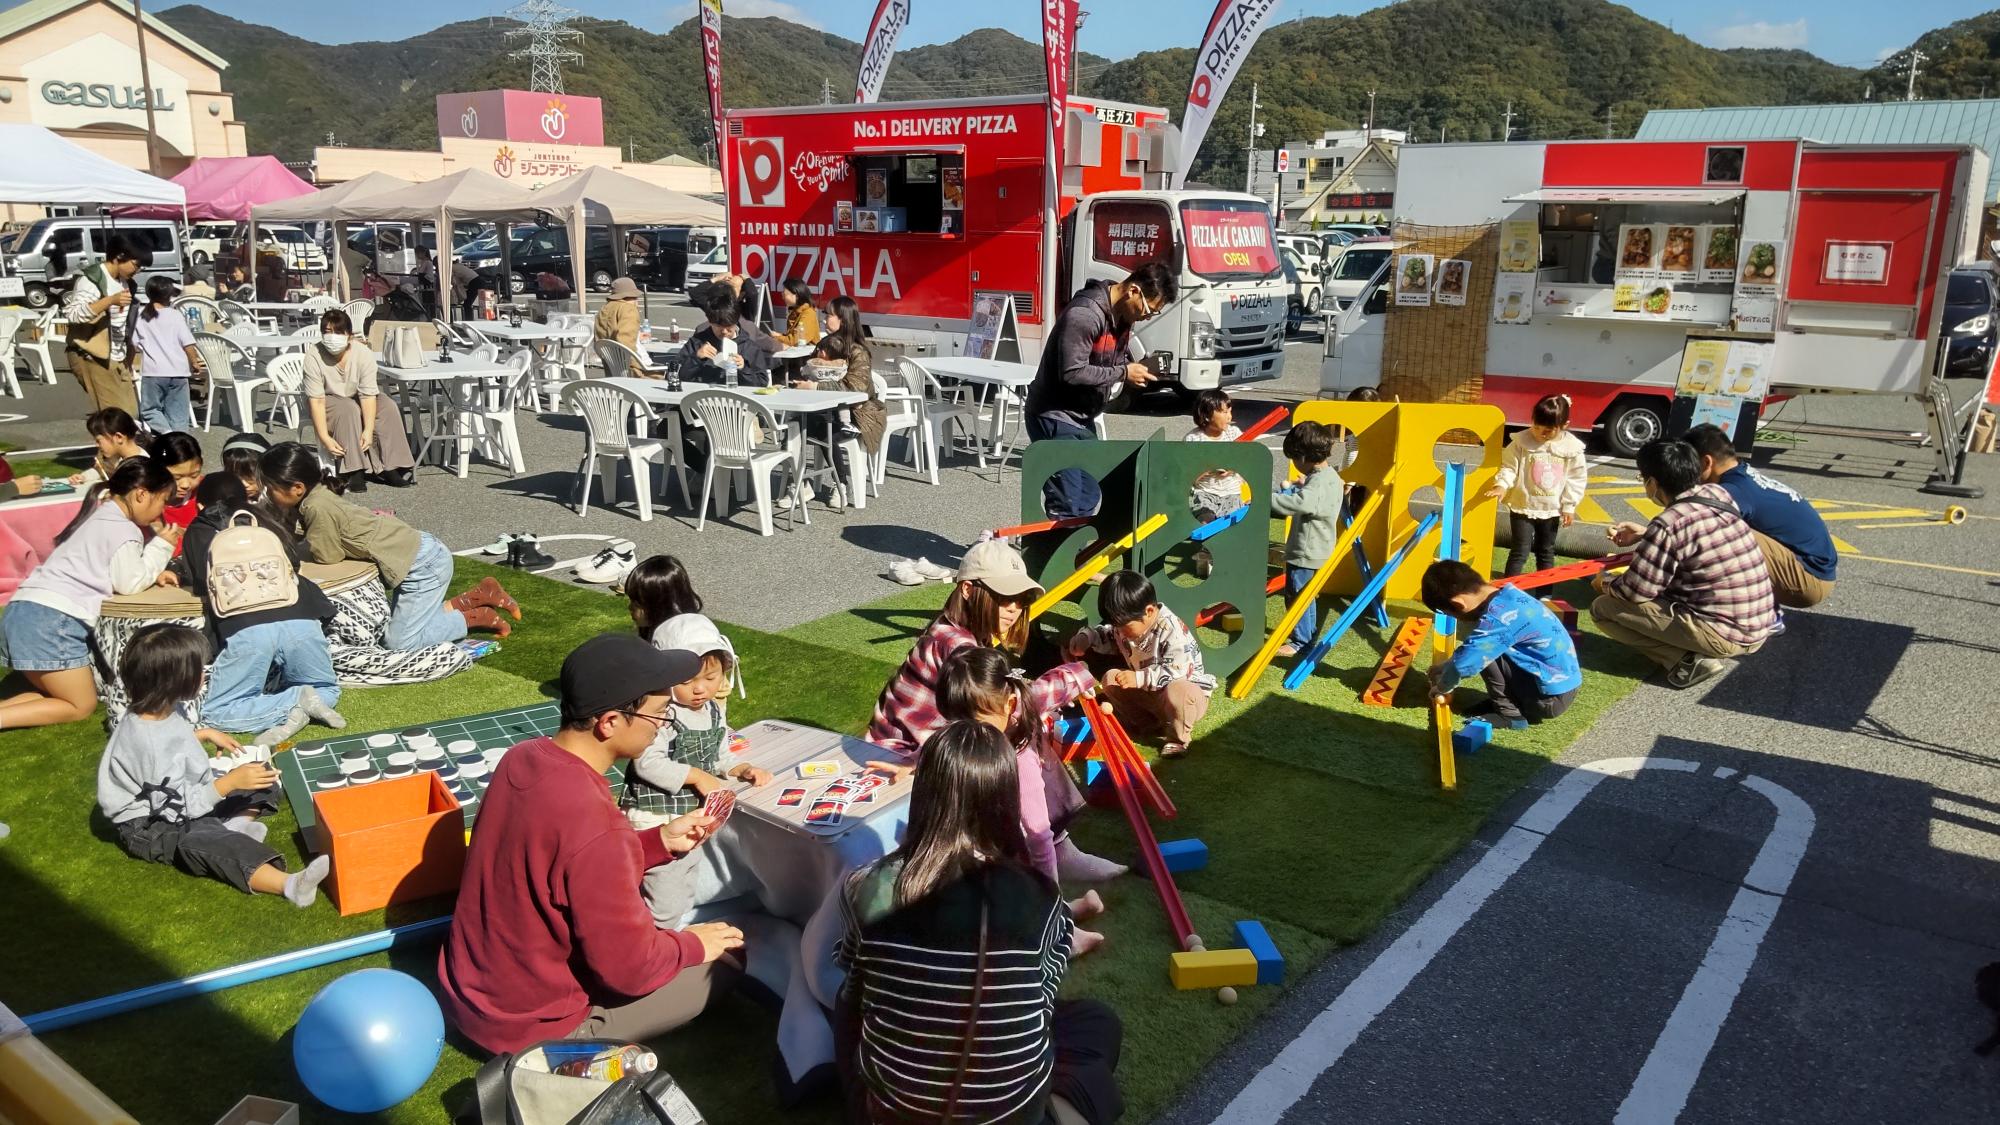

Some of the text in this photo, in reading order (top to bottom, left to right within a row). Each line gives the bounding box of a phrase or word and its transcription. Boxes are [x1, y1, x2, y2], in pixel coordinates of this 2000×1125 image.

[861, 1, 903, 90] PIZZA-LA
[867, 7, 906, 96] JAPAN STANDARD
[1217, 44, 1241, 81] JAPAN
[1096, 107, 1135, 125] 高圧ガス
[854, 114, 1018, 138] No.1 DELIVERY PIZZA
[520, 162, 584, 177] ジュンテンドー
[818, 160, 850, 192] Smile
[740, 221, 779, 237] JAPAN
[1108, 223, 1160, 238] 期間限定
[1110, 241, 1155, 256] 開催中!
[1223, 252, 1251, 267] OPEN
[741, 243, 901, 300] PIZZA-LA
[1239, 293, 1273, 309] PIZZA-LA
[1671, 304, 1698, 312] むぎたこ
